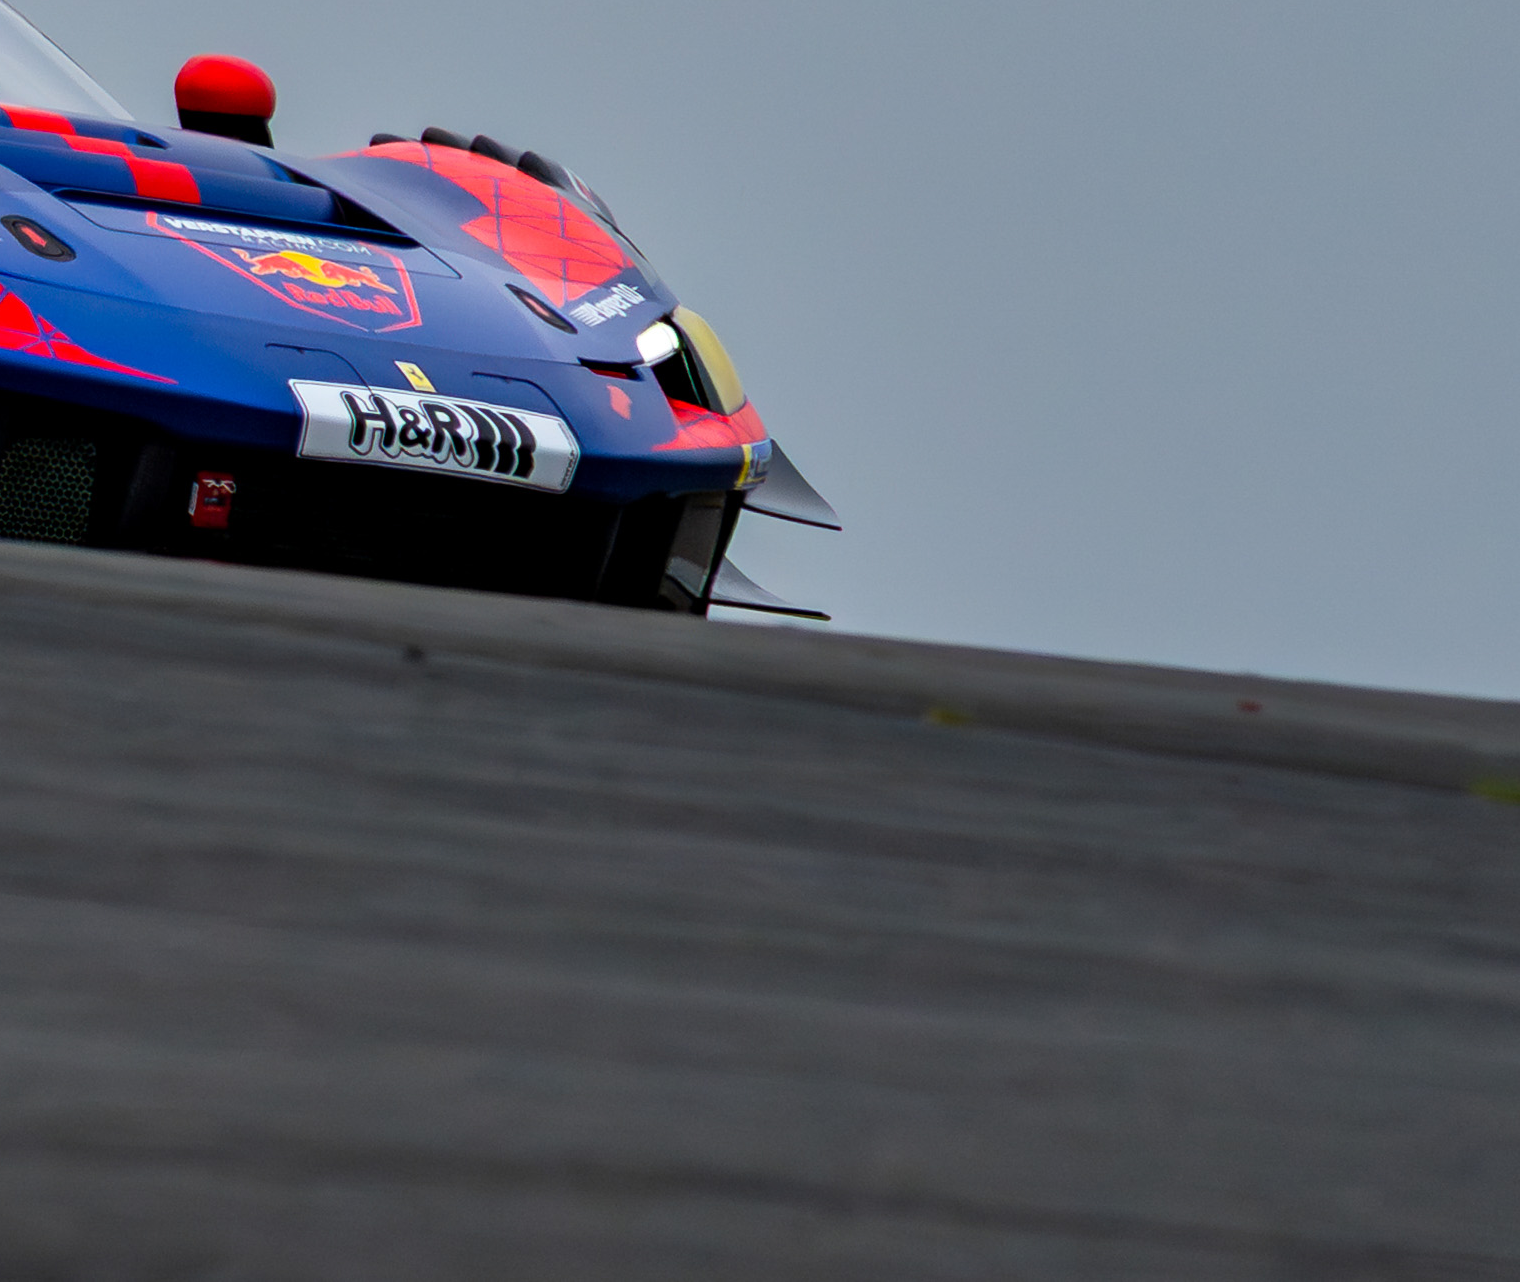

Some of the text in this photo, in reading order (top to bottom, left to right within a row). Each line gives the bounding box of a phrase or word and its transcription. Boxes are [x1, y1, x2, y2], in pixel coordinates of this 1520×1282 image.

[282, 281, 403, 316] Red Bull
[343, 392, 469, 459] H&R
